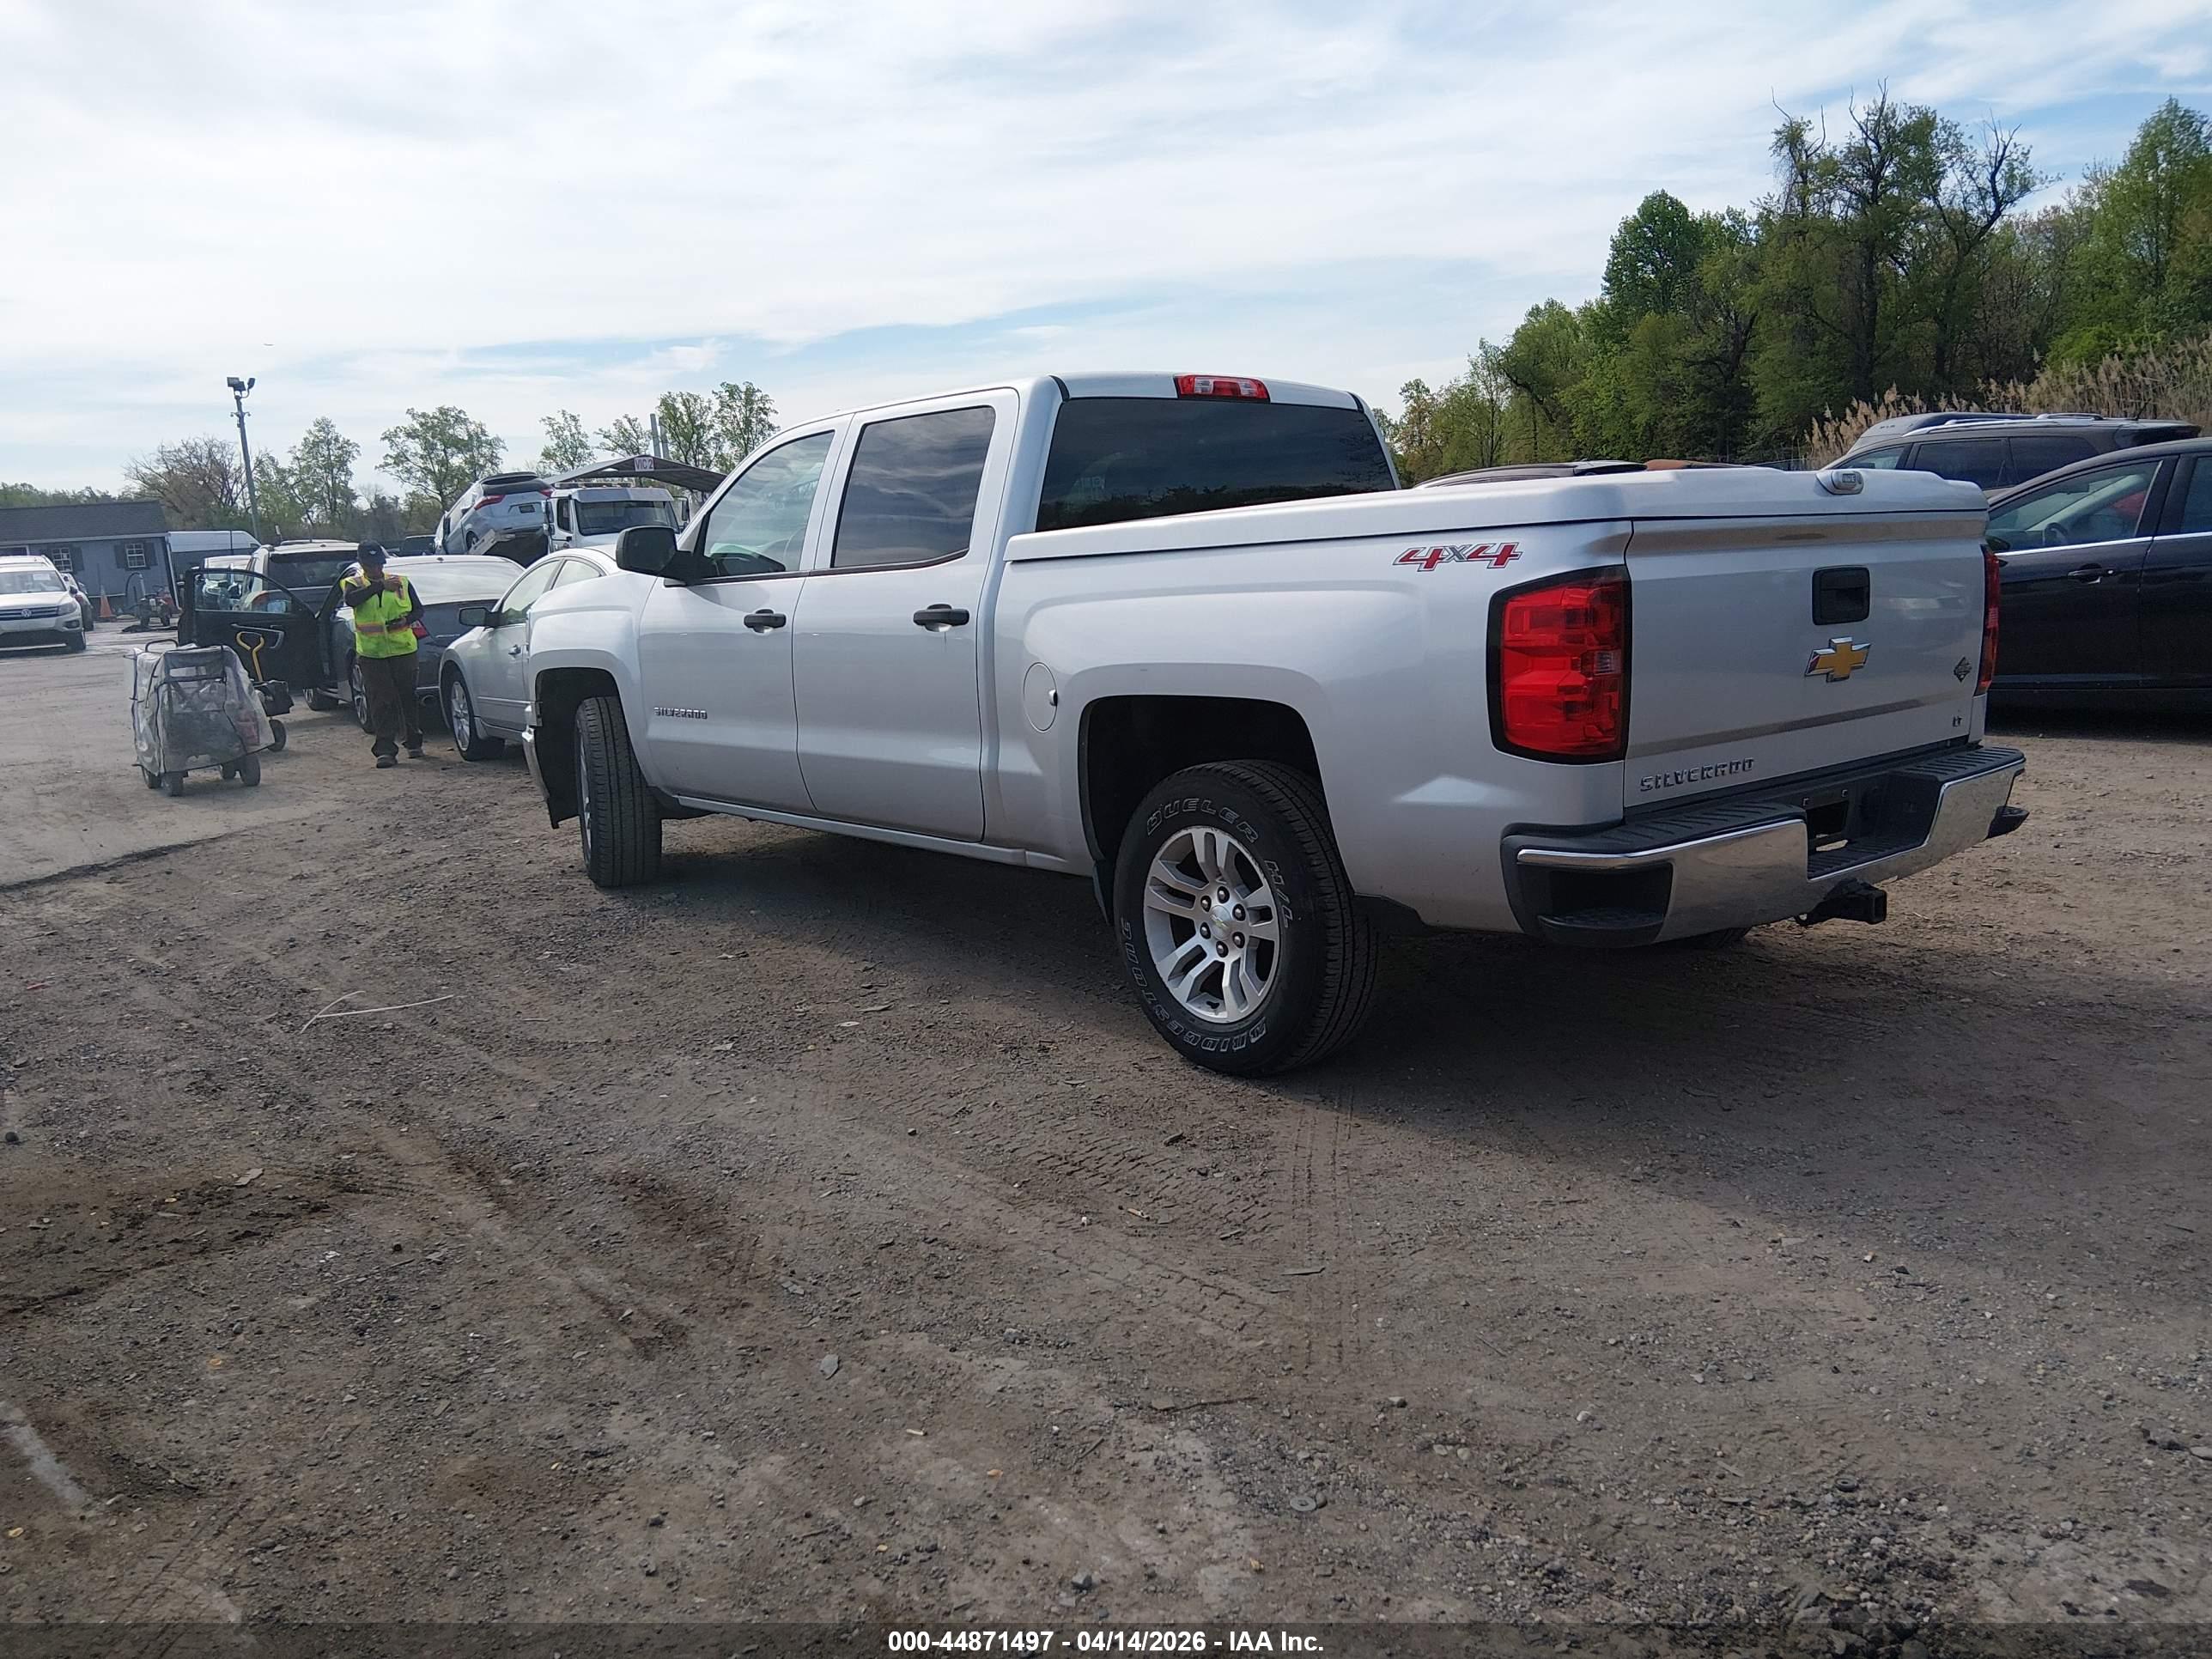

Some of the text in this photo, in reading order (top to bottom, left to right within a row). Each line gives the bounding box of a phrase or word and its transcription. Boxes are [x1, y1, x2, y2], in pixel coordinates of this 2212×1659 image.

[1639, 757, 1755, 792] SILVERADO
[1146, 798, 1259, 843] DUELER
[1121, 917, 1267, 1052] BRIDGESTONE
